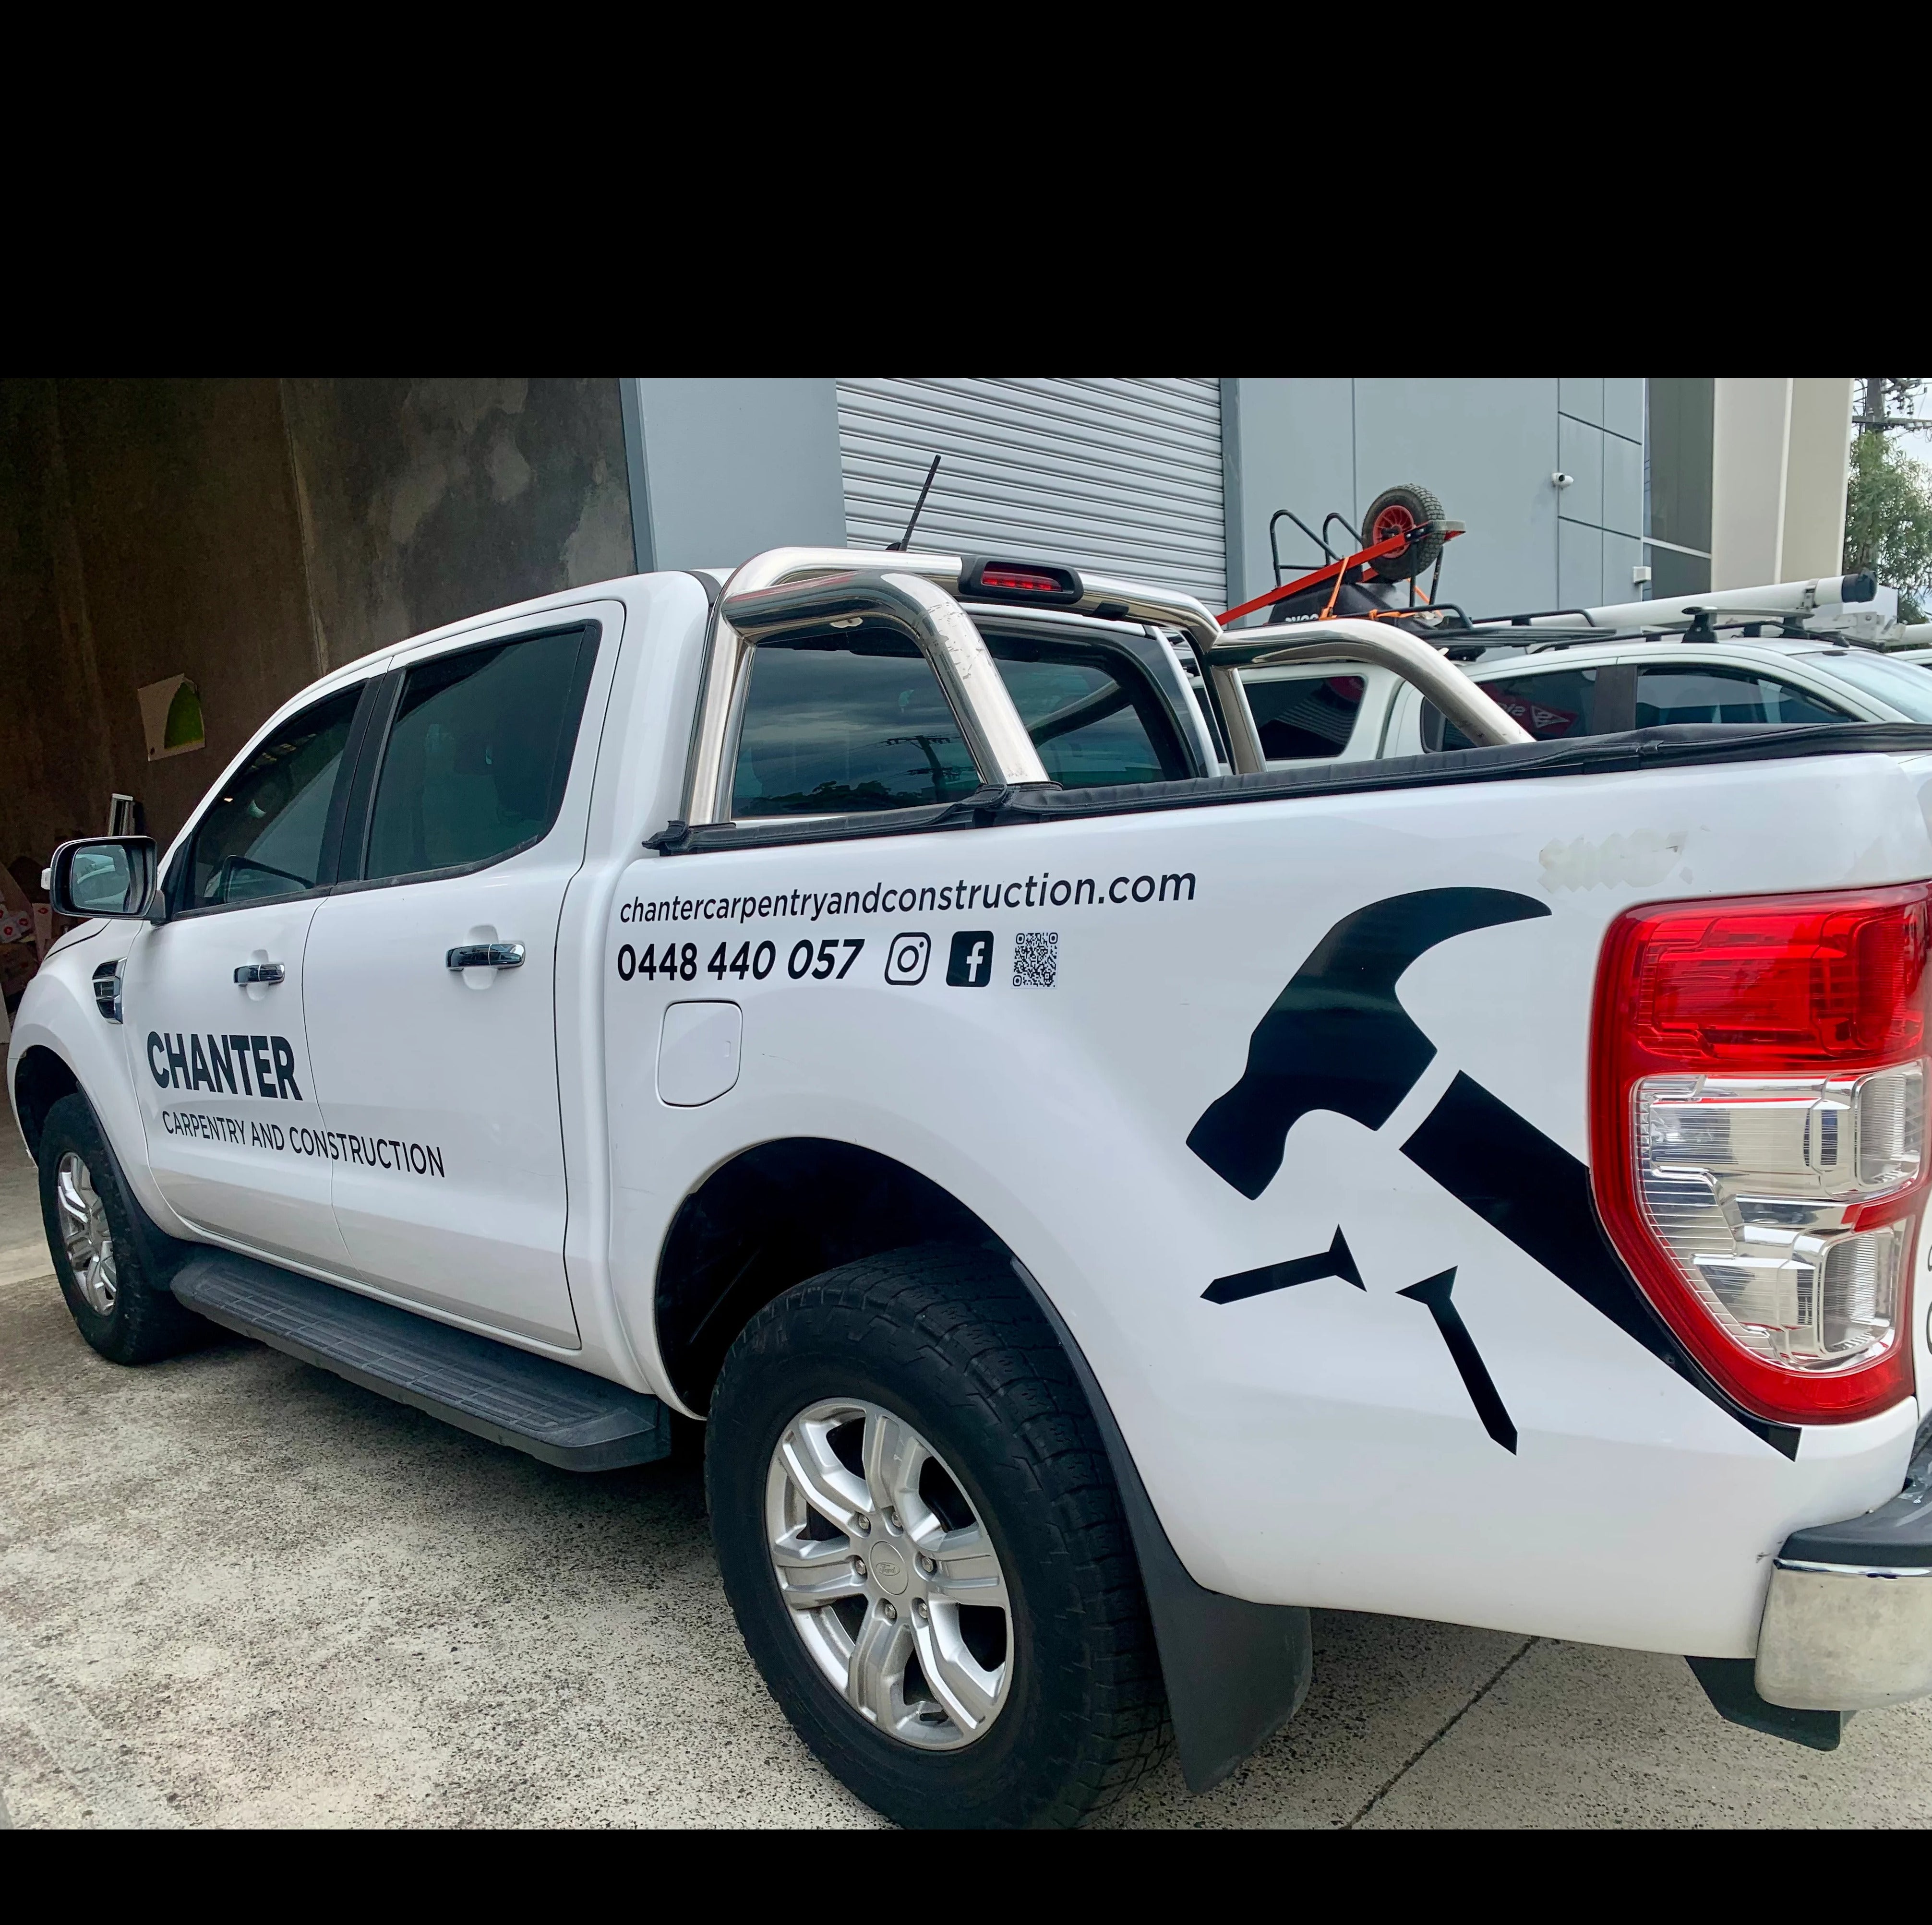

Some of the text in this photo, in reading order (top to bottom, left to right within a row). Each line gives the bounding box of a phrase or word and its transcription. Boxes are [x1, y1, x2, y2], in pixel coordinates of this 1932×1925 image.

[620, 873, 1196, 924] chantercarpentryandconstruction.com
[617, 939, 865, 981] 0448 440 057
[147, 1031, 303, 1101] CHANTER
[162, 1111, 445, 1178] CARPENTRY AND CONSTRUCTION
